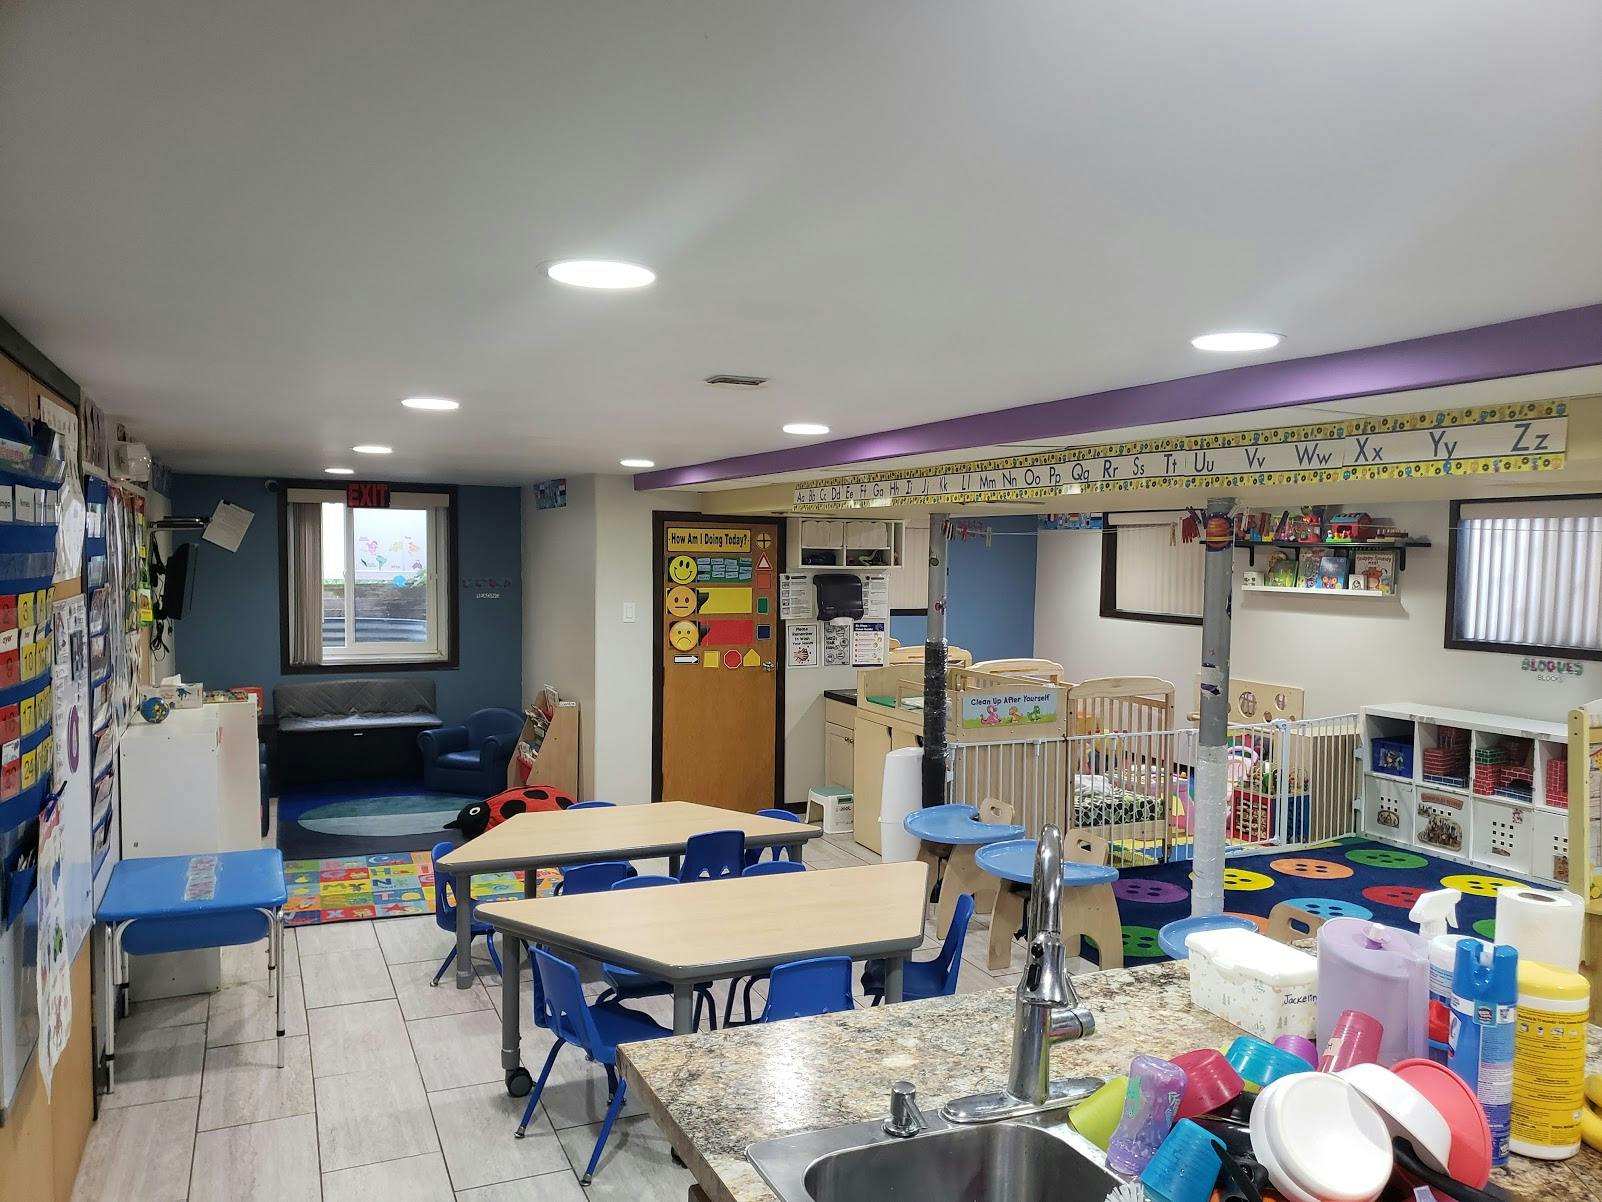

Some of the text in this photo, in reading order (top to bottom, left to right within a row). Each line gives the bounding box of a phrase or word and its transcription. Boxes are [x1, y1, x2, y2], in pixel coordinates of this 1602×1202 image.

[831, 487, 840, 500] Dd
[845, 486, 853, 499] Ee
[889, 481, 899, 496] Hh
[939, 476, 947, 492] Kk
[979, 474, 996, 489] Mm
[1002, 471, 1017, 487] Nn
[1024, 469, 1041, 486] Oo
[1049, 467, 1061, 490] Pp
[1071, 463, 1090, 484] Qq
[1102, 459, 1118, 479] Rr
[1132, 457, 1145, 476] Ss
[1163, 454, 1177, 474] Tt
[1193, 451, 1214, 473] Uu
[1244, 448, 1266, 469] Vv
[1294, 444, 1333, 466] Ww
[1353, 437, 1383, 463] Xx
[1428, 430, 1458, 459] Yy
[1511, 423, 1549, 452] Zz
[348, 483, 386, 506] EXIT
[671, 532, 686, 544] How
[687, 532, 699, 544] Am
[704, 533, 722, 547] Doing
[724, 533, 747, 548] Today?
[22, 601, 29, 621] 3
[24, 651, 33, 671] 10
[1521, 657, 1584, 676] BLOQUES
[970, 694, 1051, 706] Clean Up After Yourself
